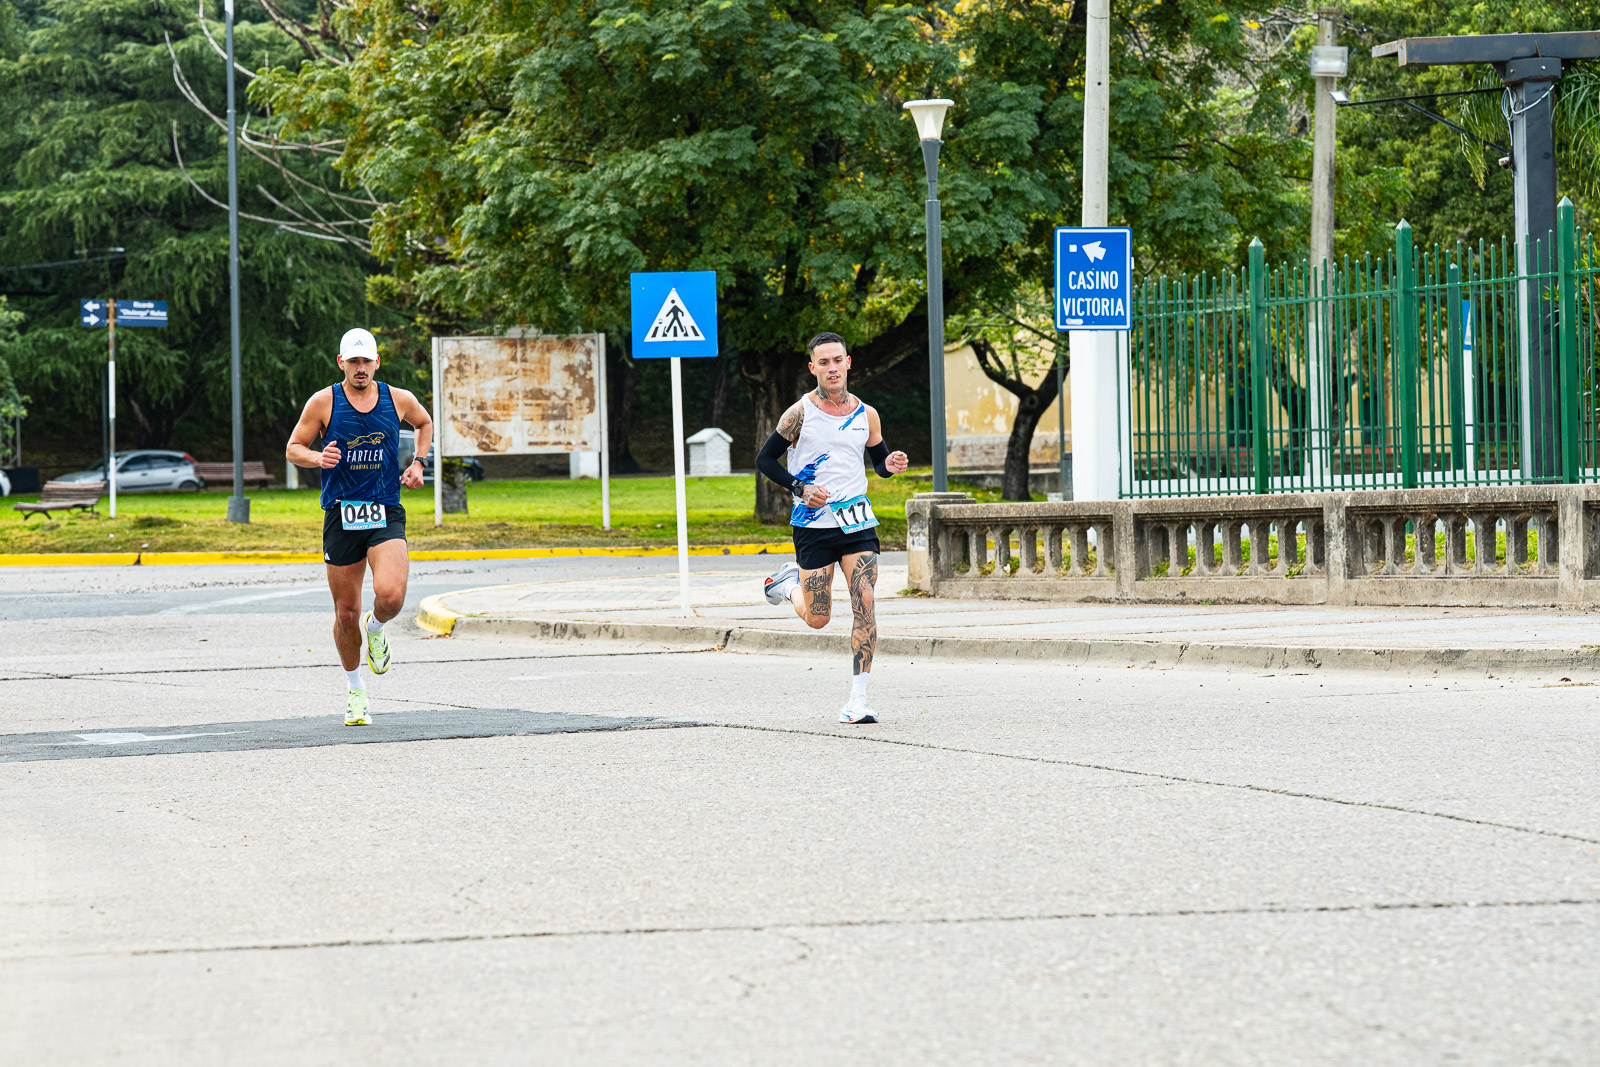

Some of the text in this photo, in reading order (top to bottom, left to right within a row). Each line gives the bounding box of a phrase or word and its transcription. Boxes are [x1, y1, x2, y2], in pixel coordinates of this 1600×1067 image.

[1068, 271, 1119, 290] CASINO
[1062, 297, 1125, 317] VICTORIA
[344, 503, 382, 524] 048
[836, 500, 869, 527] 117
